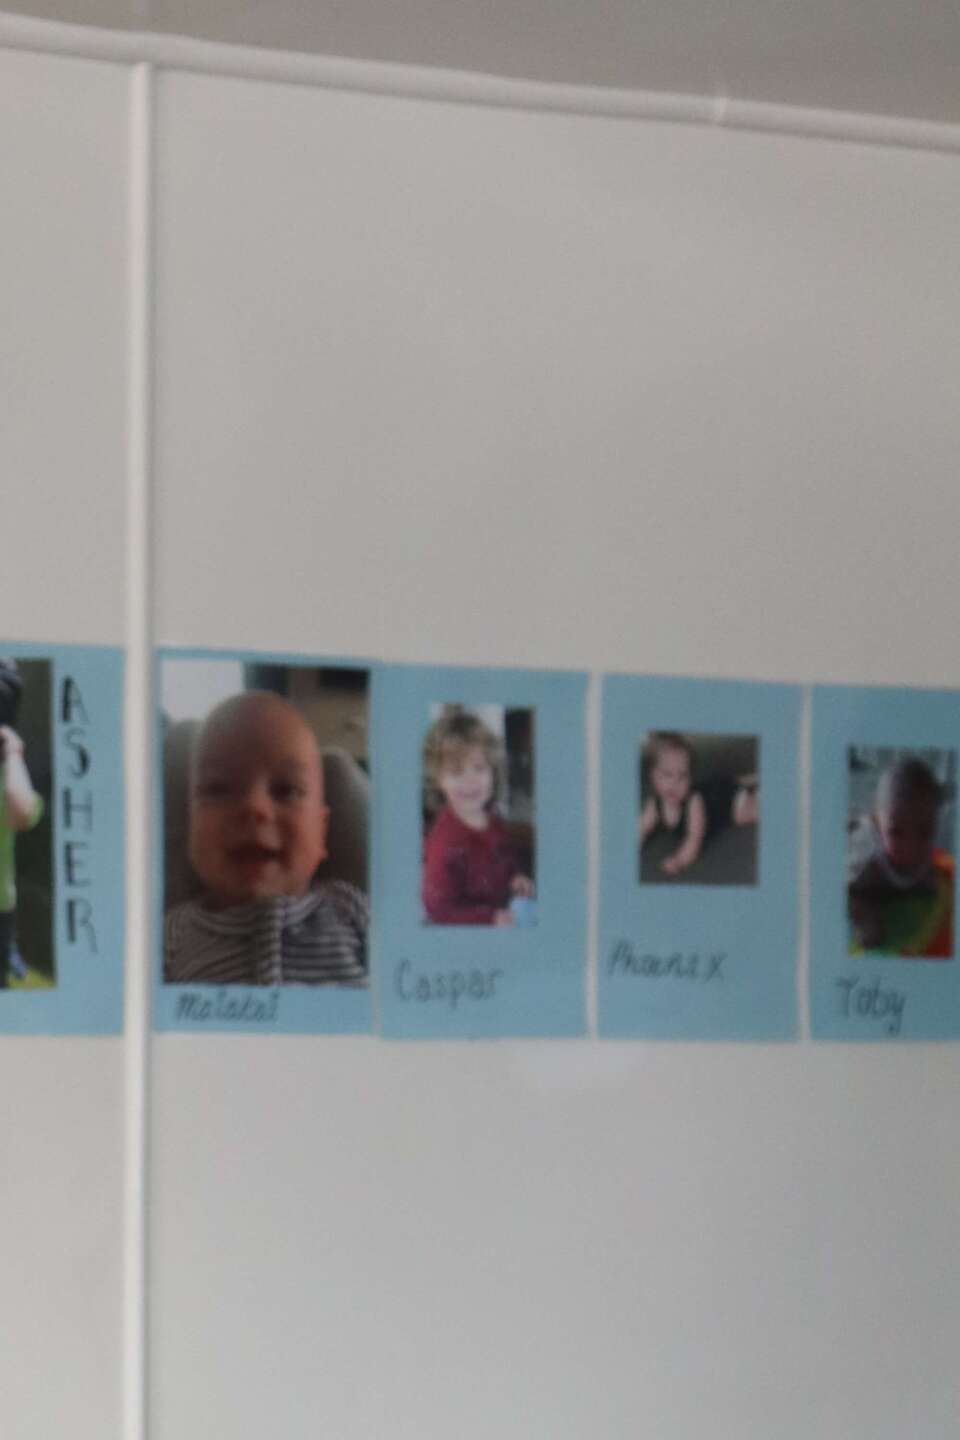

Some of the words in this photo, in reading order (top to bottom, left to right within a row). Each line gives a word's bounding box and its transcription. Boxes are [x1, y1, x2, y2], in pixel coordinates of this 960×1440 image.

[60, 674, 98, 954] ASHER
[394, 957, 505, 1009] Caspar
[836, 974, 906, 1036] Toby
